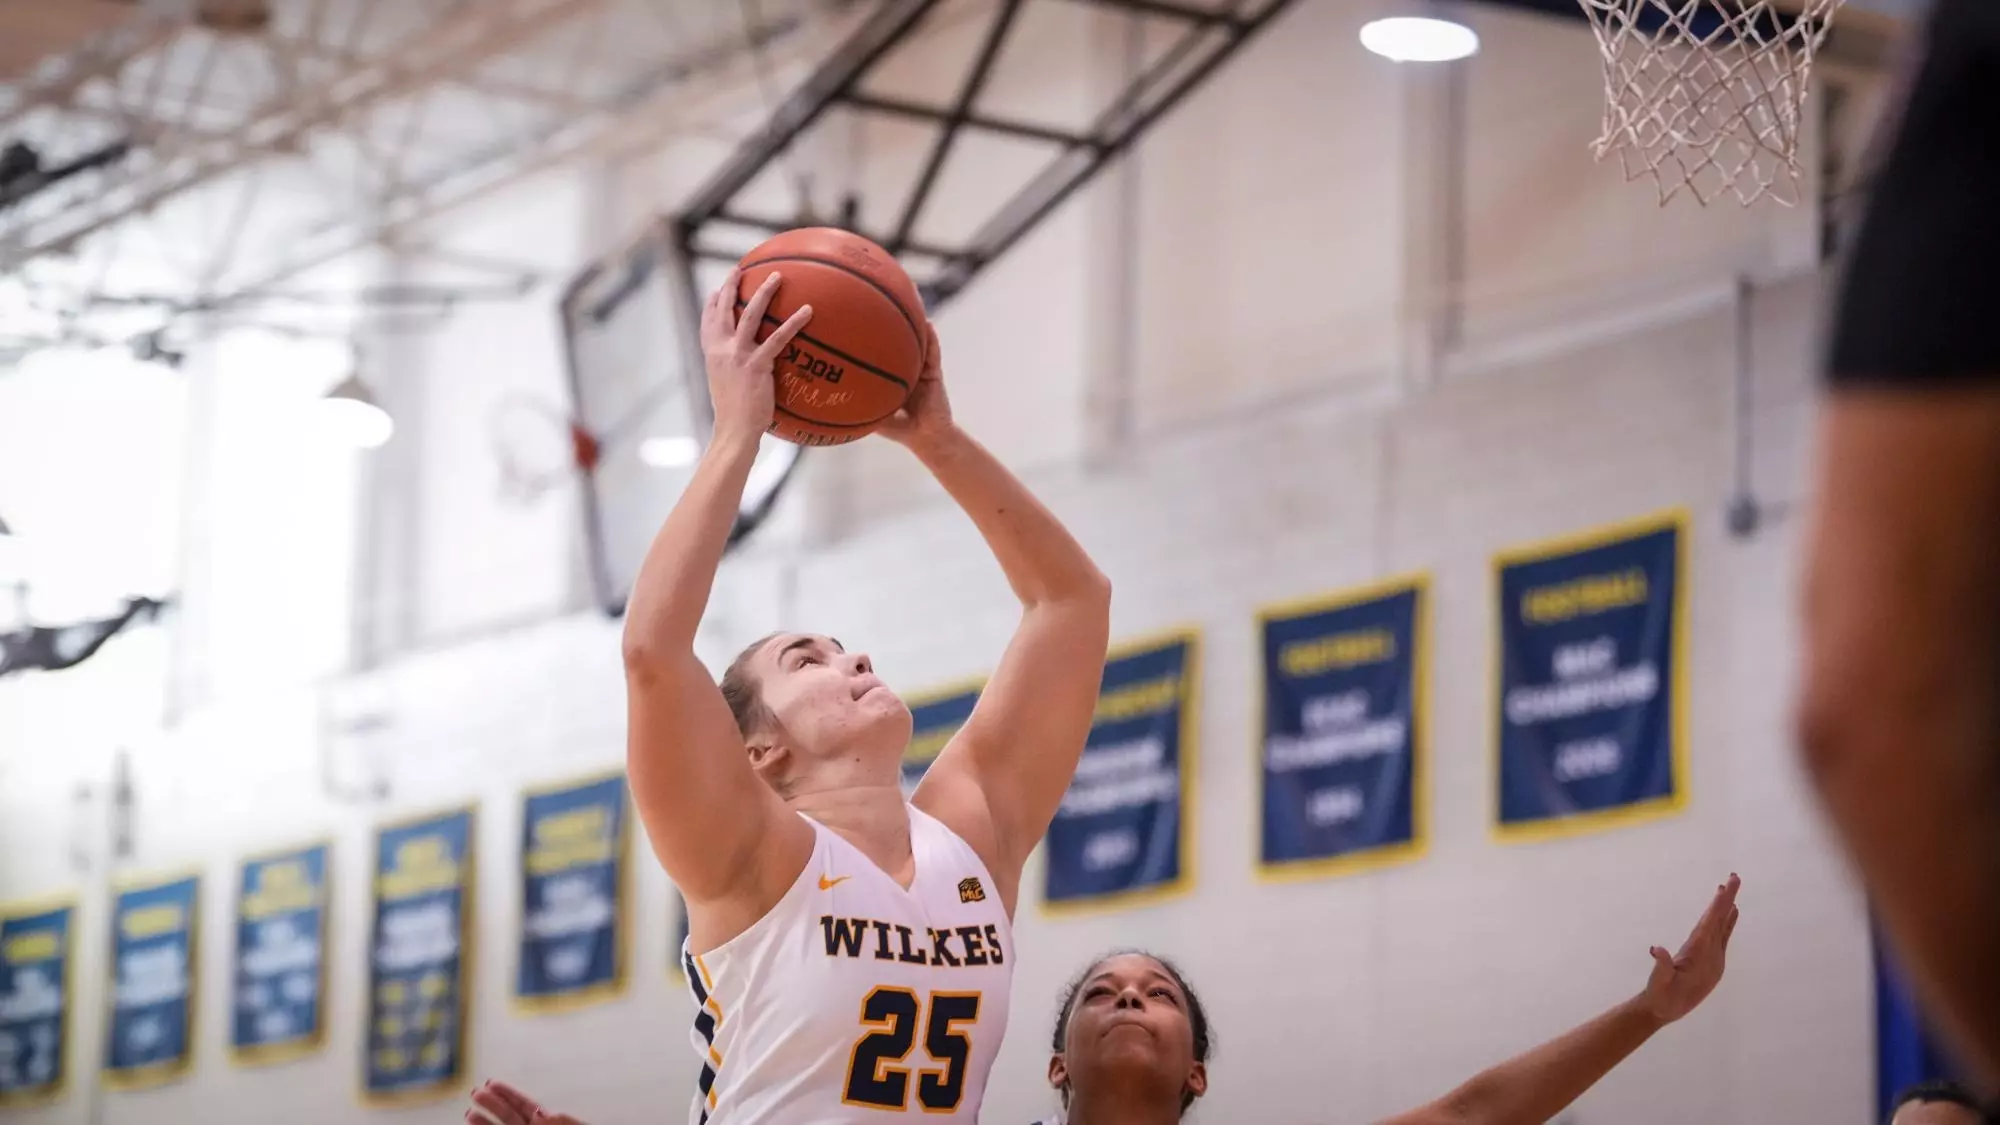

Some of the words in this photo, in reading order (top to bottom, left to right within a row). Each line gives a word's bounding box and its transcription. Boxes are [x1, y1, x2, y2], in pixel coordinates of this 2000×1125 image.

[780, 343, 844, 384] ROCK
[820, 915, 1004, 967] WILKES
[841, 984, 982, 1114] 25
